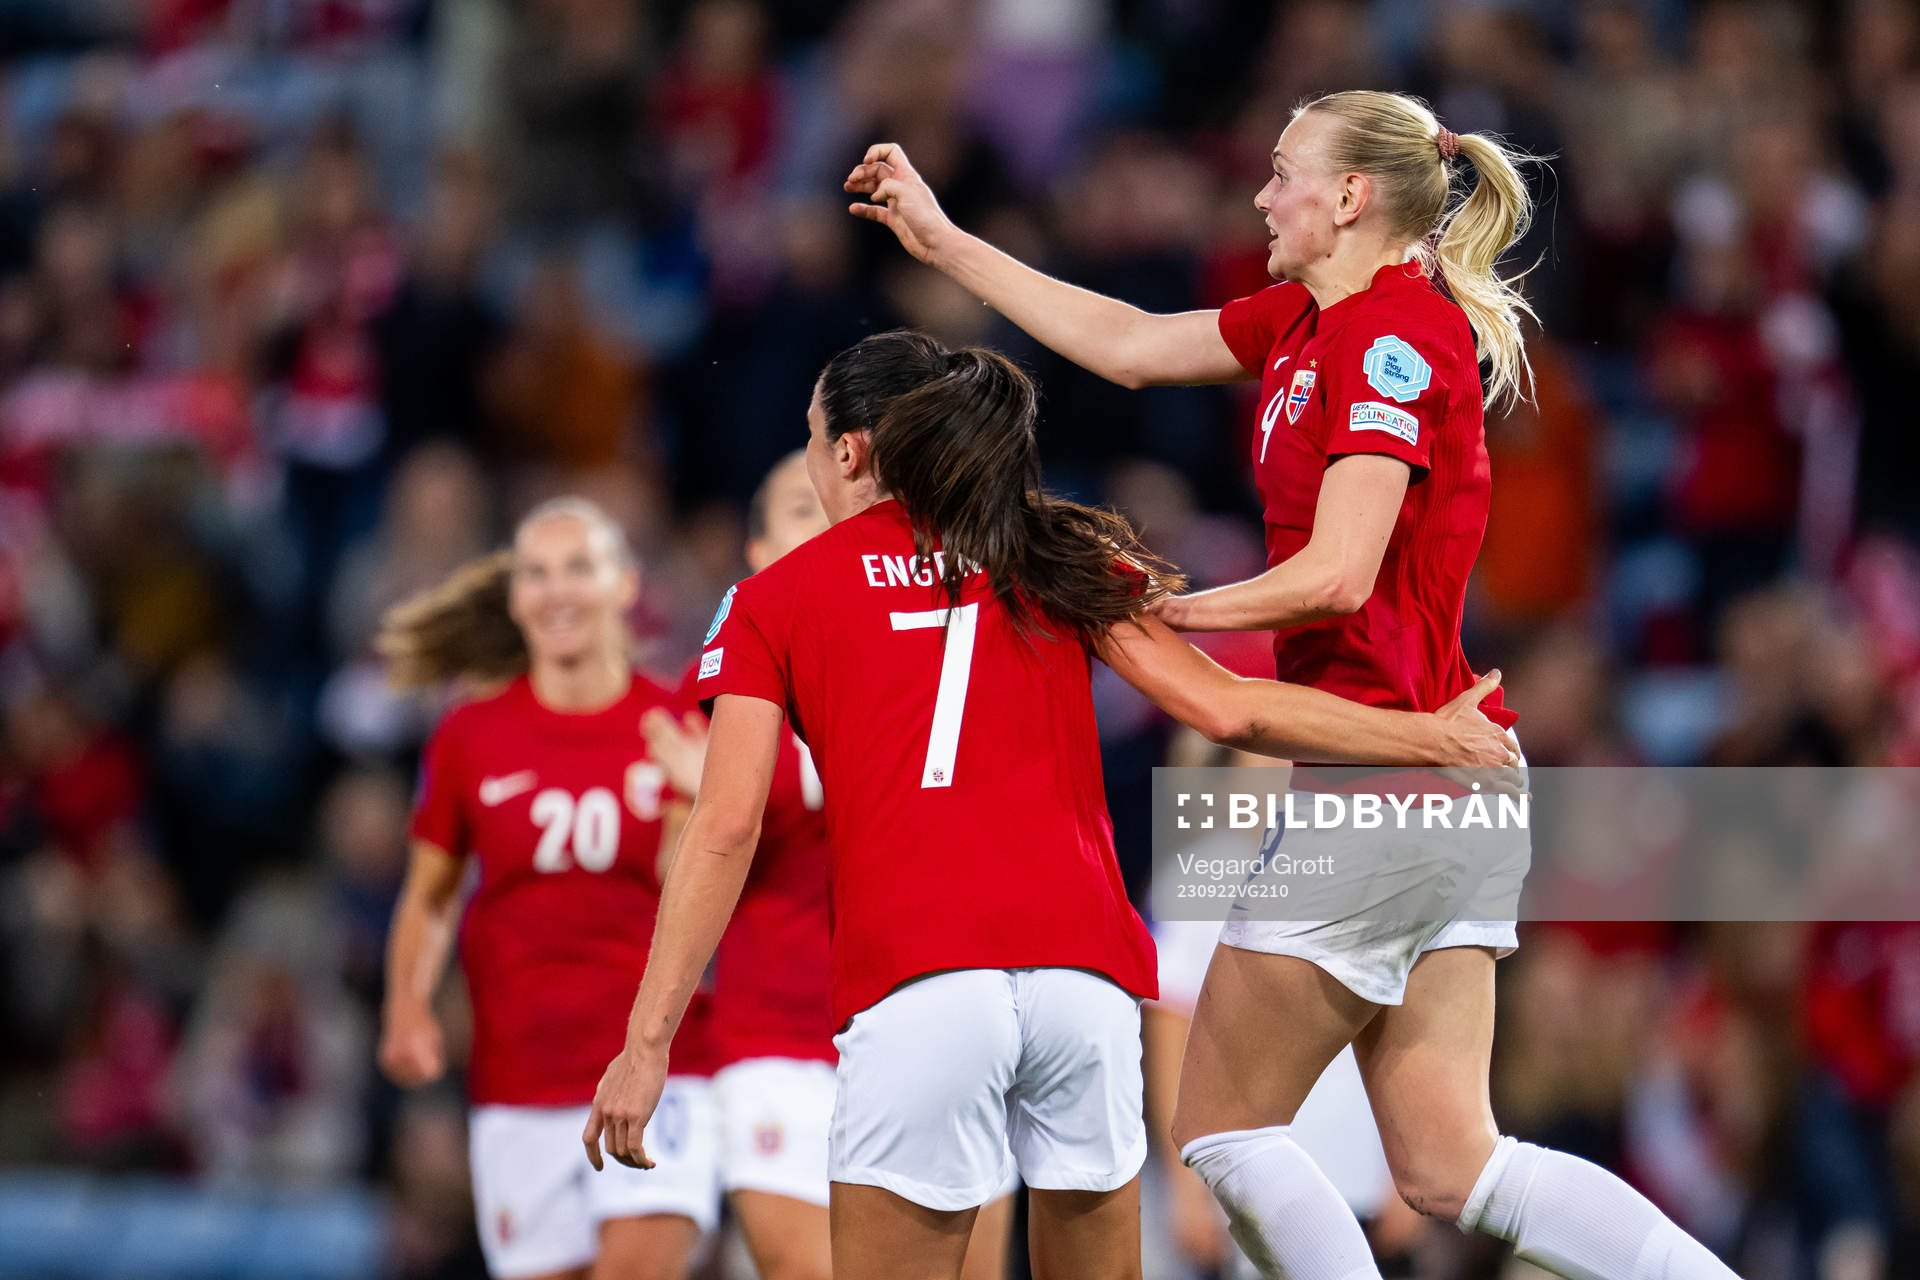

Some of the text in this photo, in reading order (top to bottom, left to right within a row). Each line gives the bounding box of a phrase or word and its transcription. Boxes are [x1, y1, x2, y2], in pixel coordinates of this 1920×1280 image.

[1261, 387, 1285, 464] 9
[1352, 403, 1370, 411] UEFA
[1352, 410, 1417, 436] FOUNDATION
[888, 602, 979, 788] 7
[530, 789, 621, 873] 20
